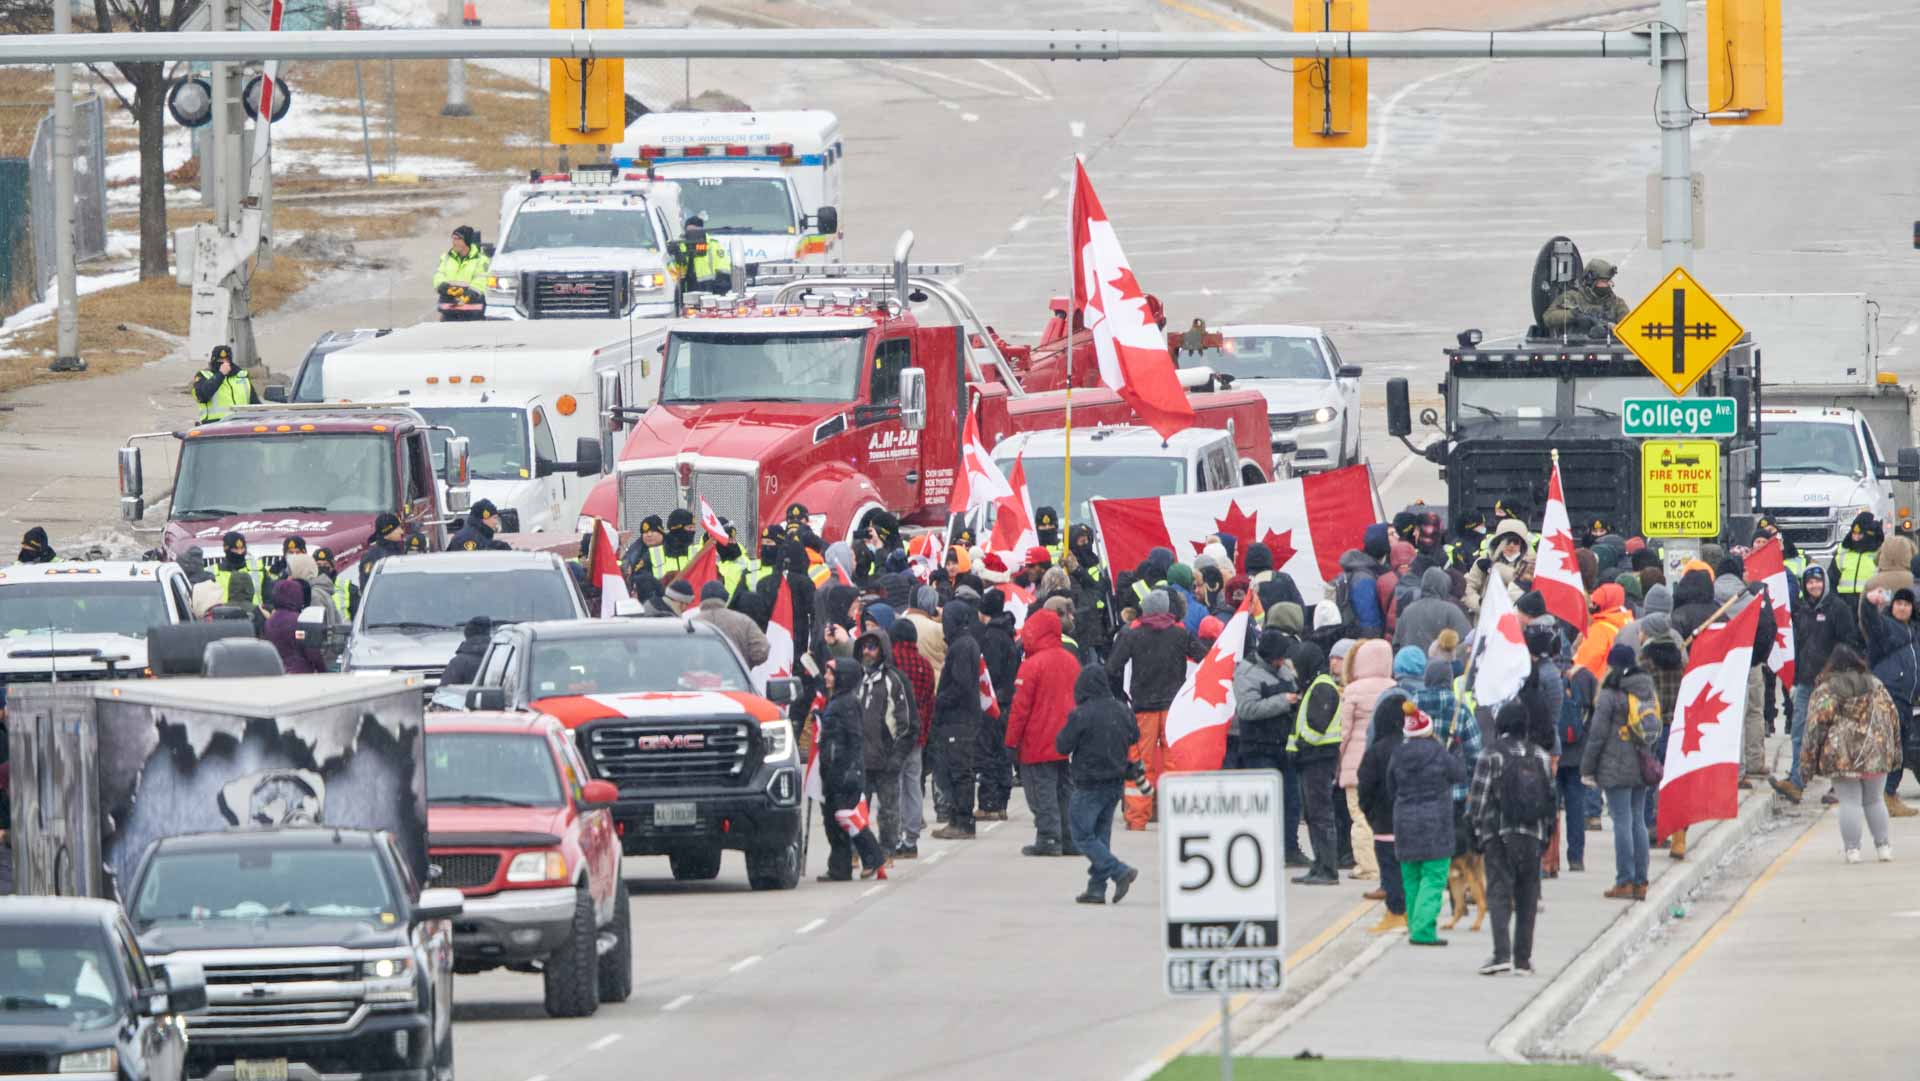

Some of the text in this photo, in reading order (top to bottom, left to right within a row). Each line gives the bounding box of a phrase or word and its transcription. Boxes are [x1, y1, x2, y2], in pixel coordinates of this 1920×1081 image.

[1625, 403, 1732, 433] College Ave.
[1649, 470, 1712, 480] FIRE TRUCK
[764, 474, 778, 496] 79
[1664, 483, 1699, 494] ROUTE
[1664, 500, 1697, 508] DO NOT
[1666, 511, 1695, 519] BLOCK
[1649, 521, 1712, 529] INTERSECTION
[639, 734, 704, 750] GMC
[1172, 793, 1269, 816] MAXIMUM
[1179, 832, 1263, 890] 50
[1180, 921, 1266, 949] km/h
[1169, 957, 1280, 992] BEGINS
